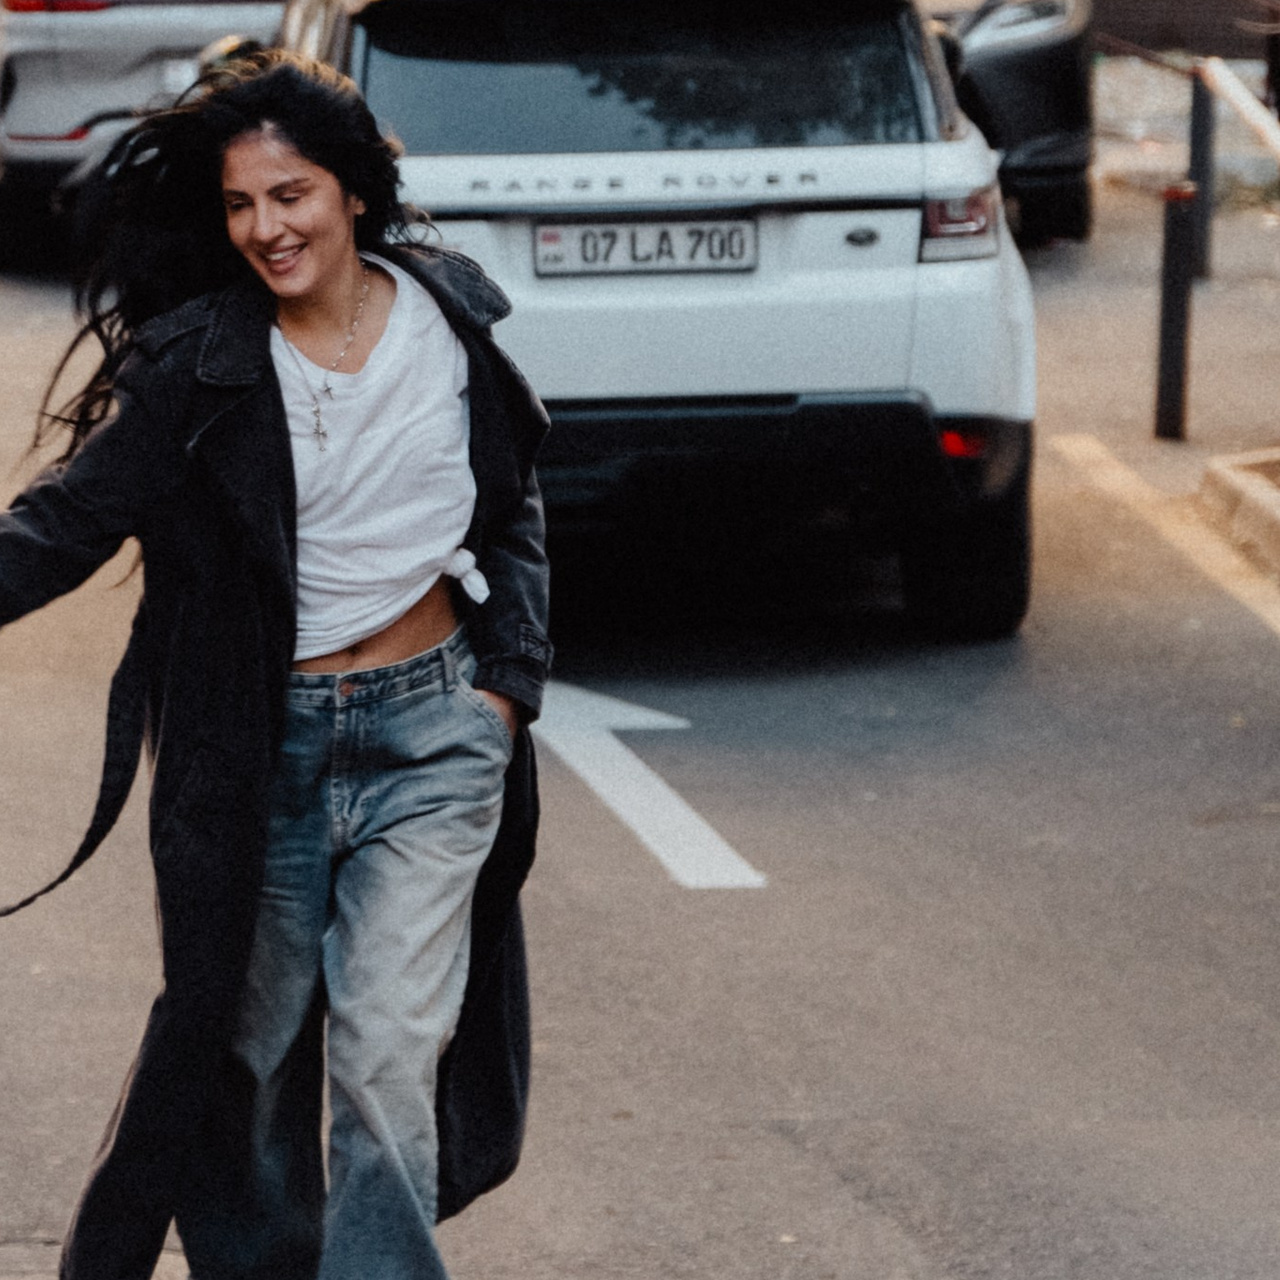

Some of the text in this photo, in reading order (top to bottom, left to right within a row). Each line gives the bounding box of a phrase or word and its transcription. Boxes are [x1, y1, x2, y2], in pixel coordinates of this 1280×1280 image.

[470, 172, 819, 192] RANGE ROVER
[580, 227, 745, 263] 07 LA 700
